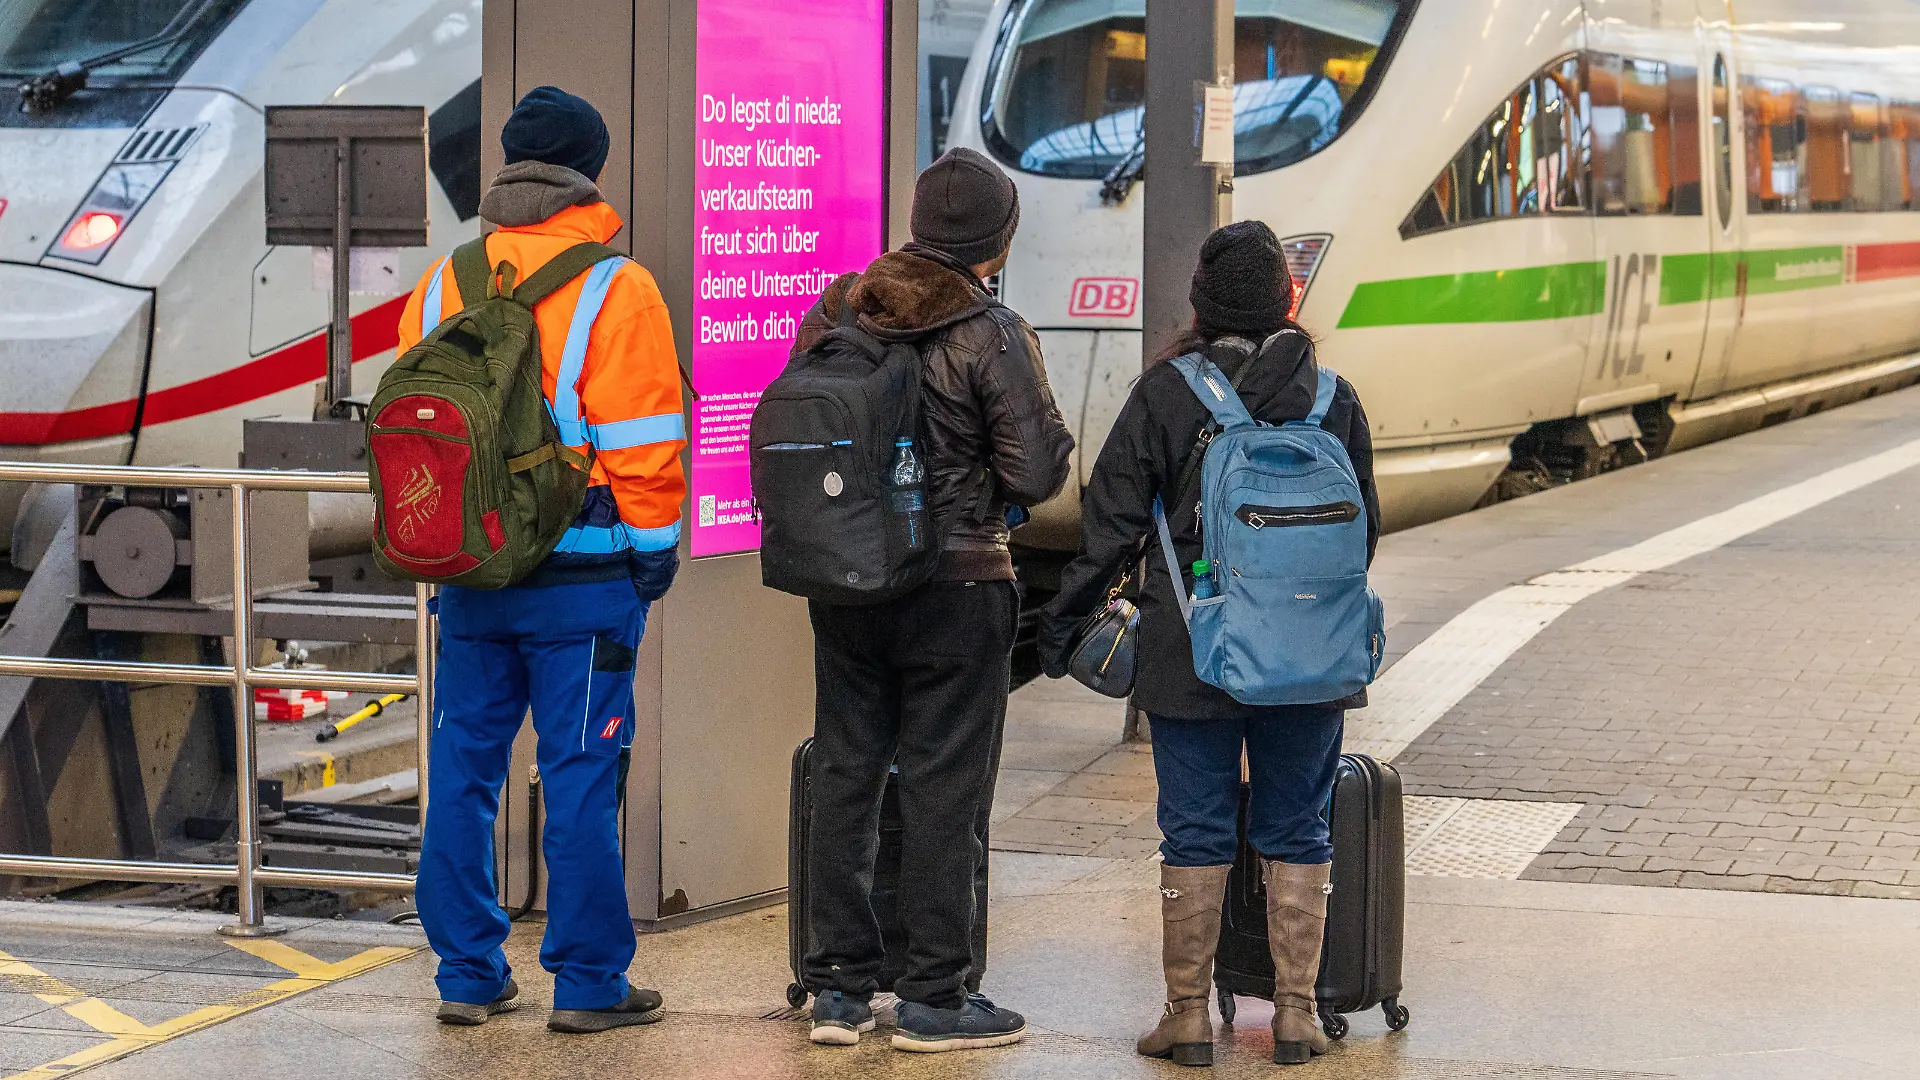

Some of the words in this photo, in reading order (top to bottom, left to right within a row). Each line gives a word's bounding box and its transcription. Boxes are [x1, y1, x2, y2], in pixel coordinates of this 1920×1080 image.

[702, 94, 726, 123] Do
[731, 92, 771, 132] legst
[775, 94, 790, 124] di
[795, 95, 842, 125] nieda:
[702, 138, 751, 167] Unser
[756, 137, 821, 167] Küchen-
[701, 181, 813, 211] verkaufsteam
[700, 225, 742, 255] freut
[746, 224, 777, 254] sich
[782, 224, 820, 253] über
[700, 269, 747, 300] deine
[751, 267, 839, 298] Unterstütz
[1077, 283, 1129, 311] DB
[700, 312, 758, 344] Bewirb
[762, 310, 796, 341] dich
[1596, 252, 1658, 380] ICE
[717, 500, 732, 511] Mehr
[732, 498, 740, 509] als
[740, 498, 750, 508] ein
